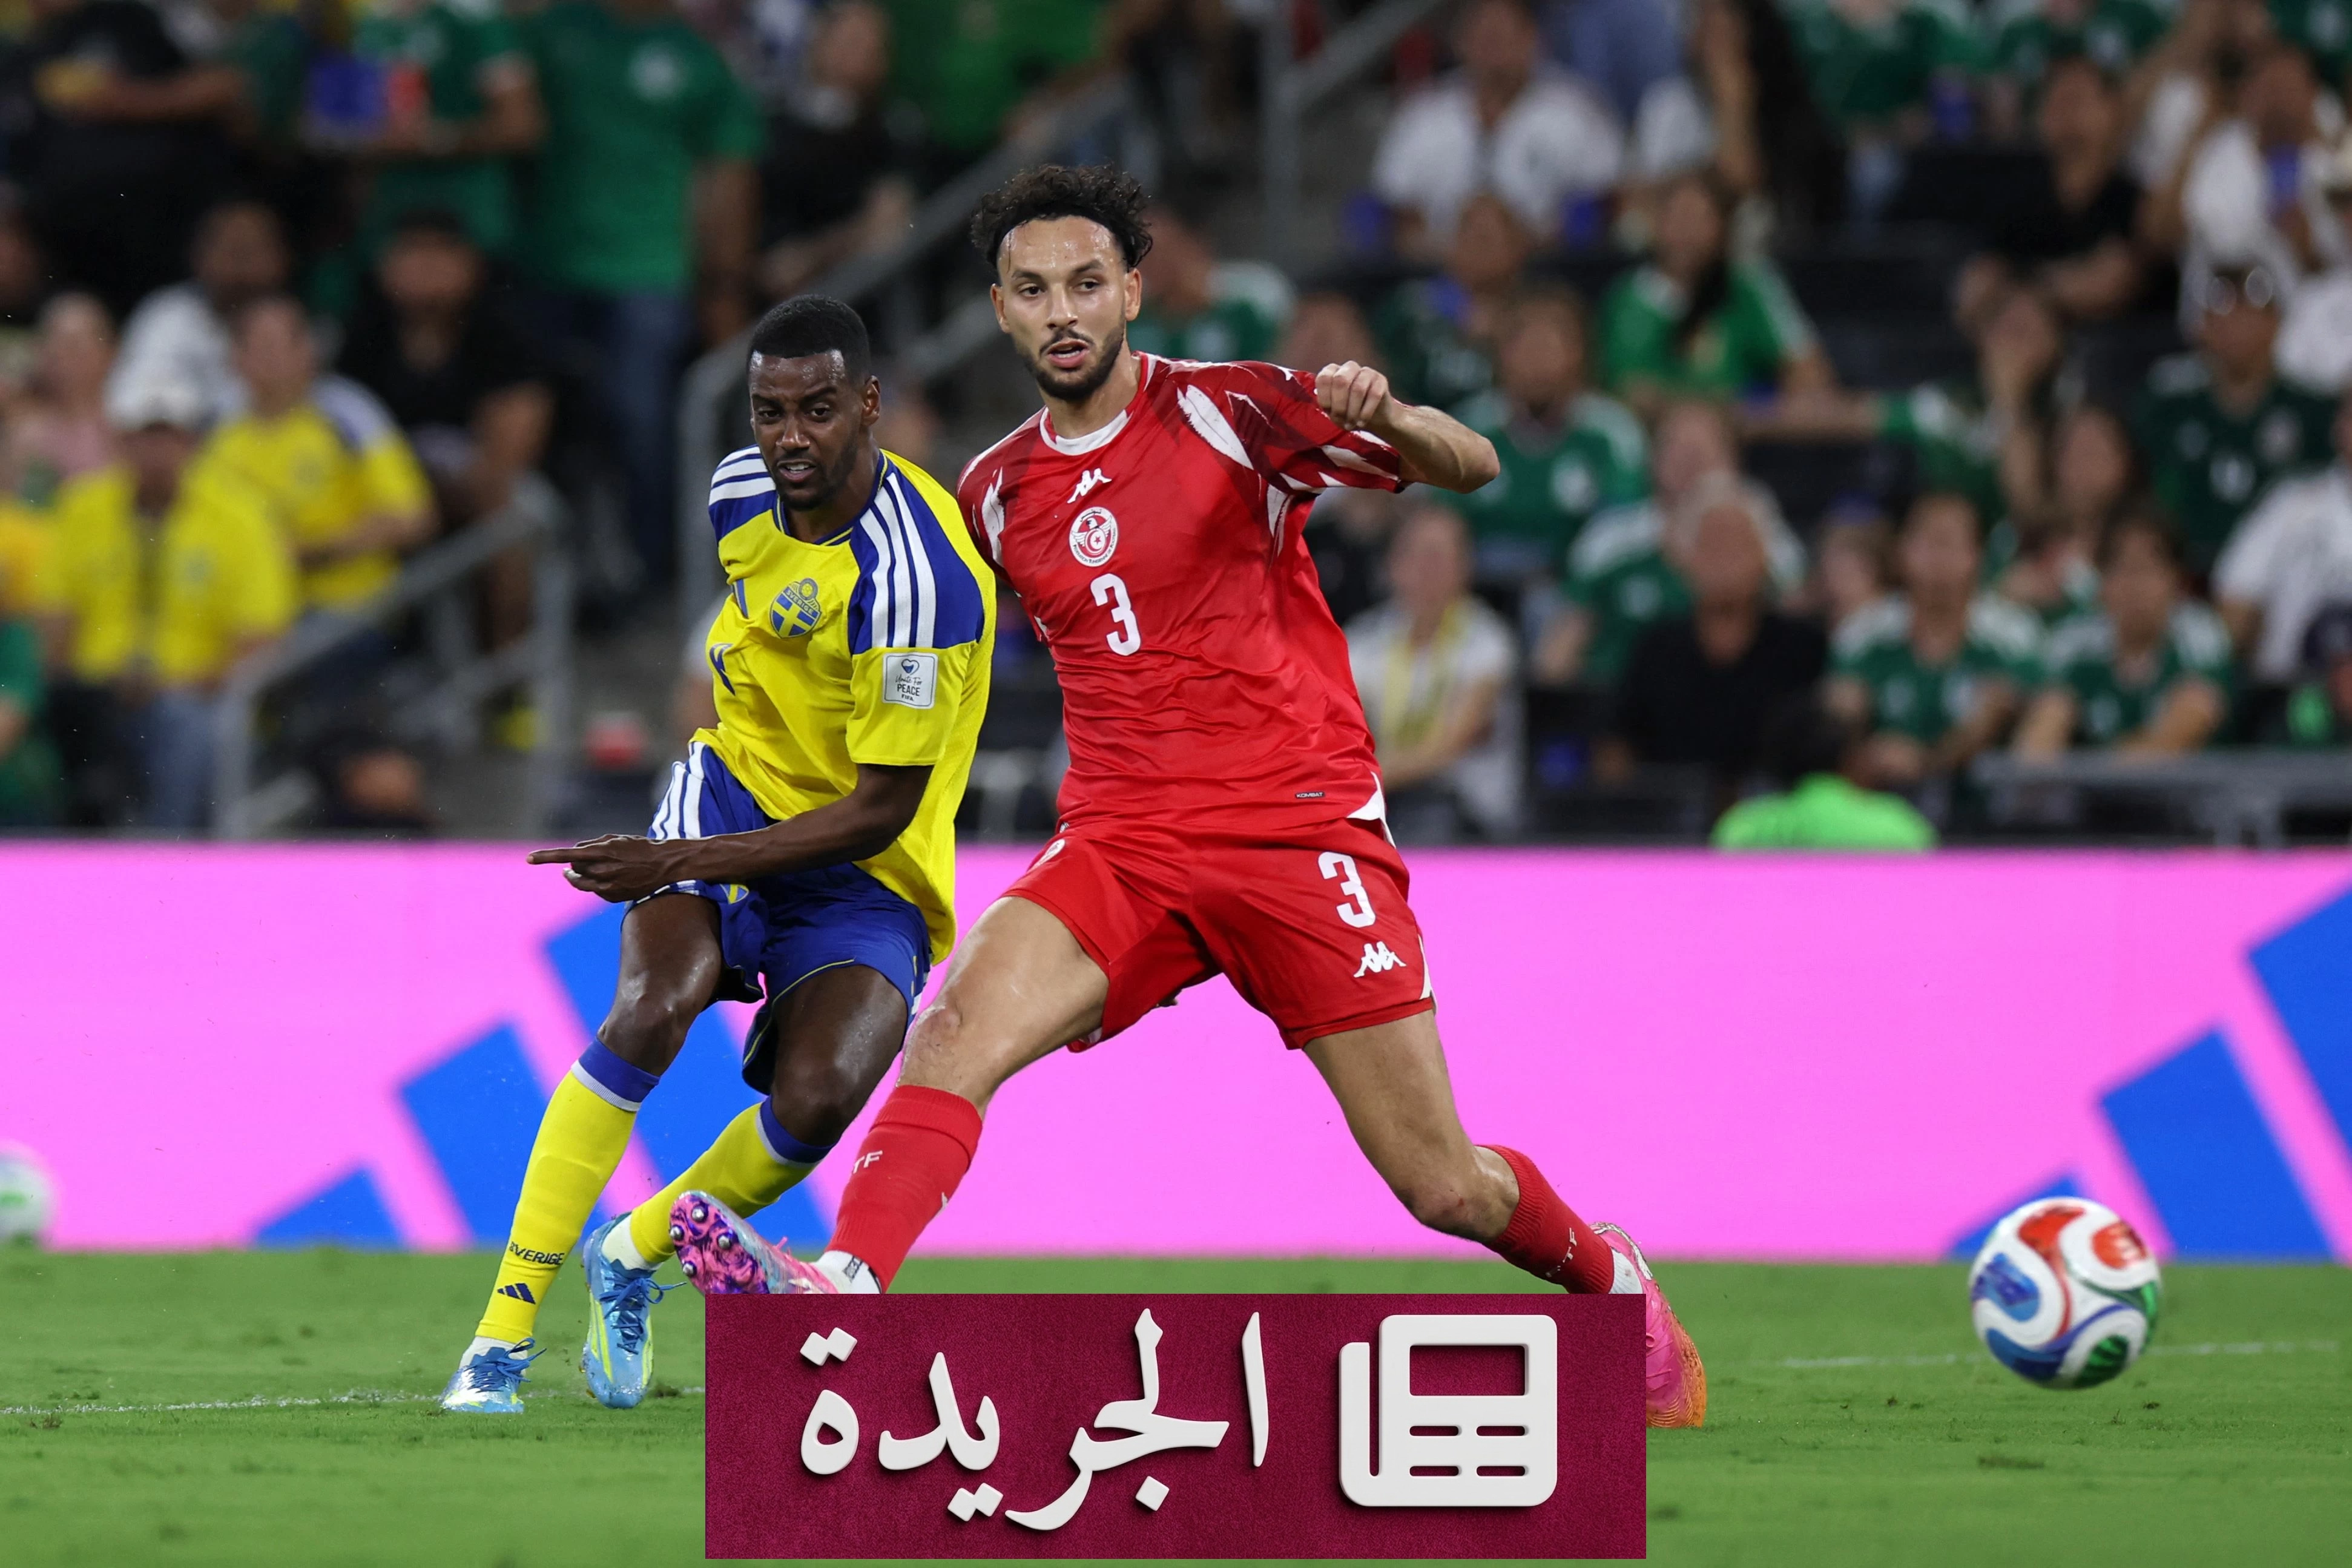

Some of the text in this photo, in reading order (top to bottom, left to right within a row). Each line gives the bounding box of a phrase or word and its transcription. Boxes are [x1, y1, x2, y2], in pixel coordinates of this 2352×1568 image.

[786, 589, 813, 615] SVERIGE
[1090, 573, 1141, 656] 3
[897, 684, 920, 696] PEACE
[1318, 851, 1375, 927] 3
[509, 1241, 565, 1265] SVERIGE
